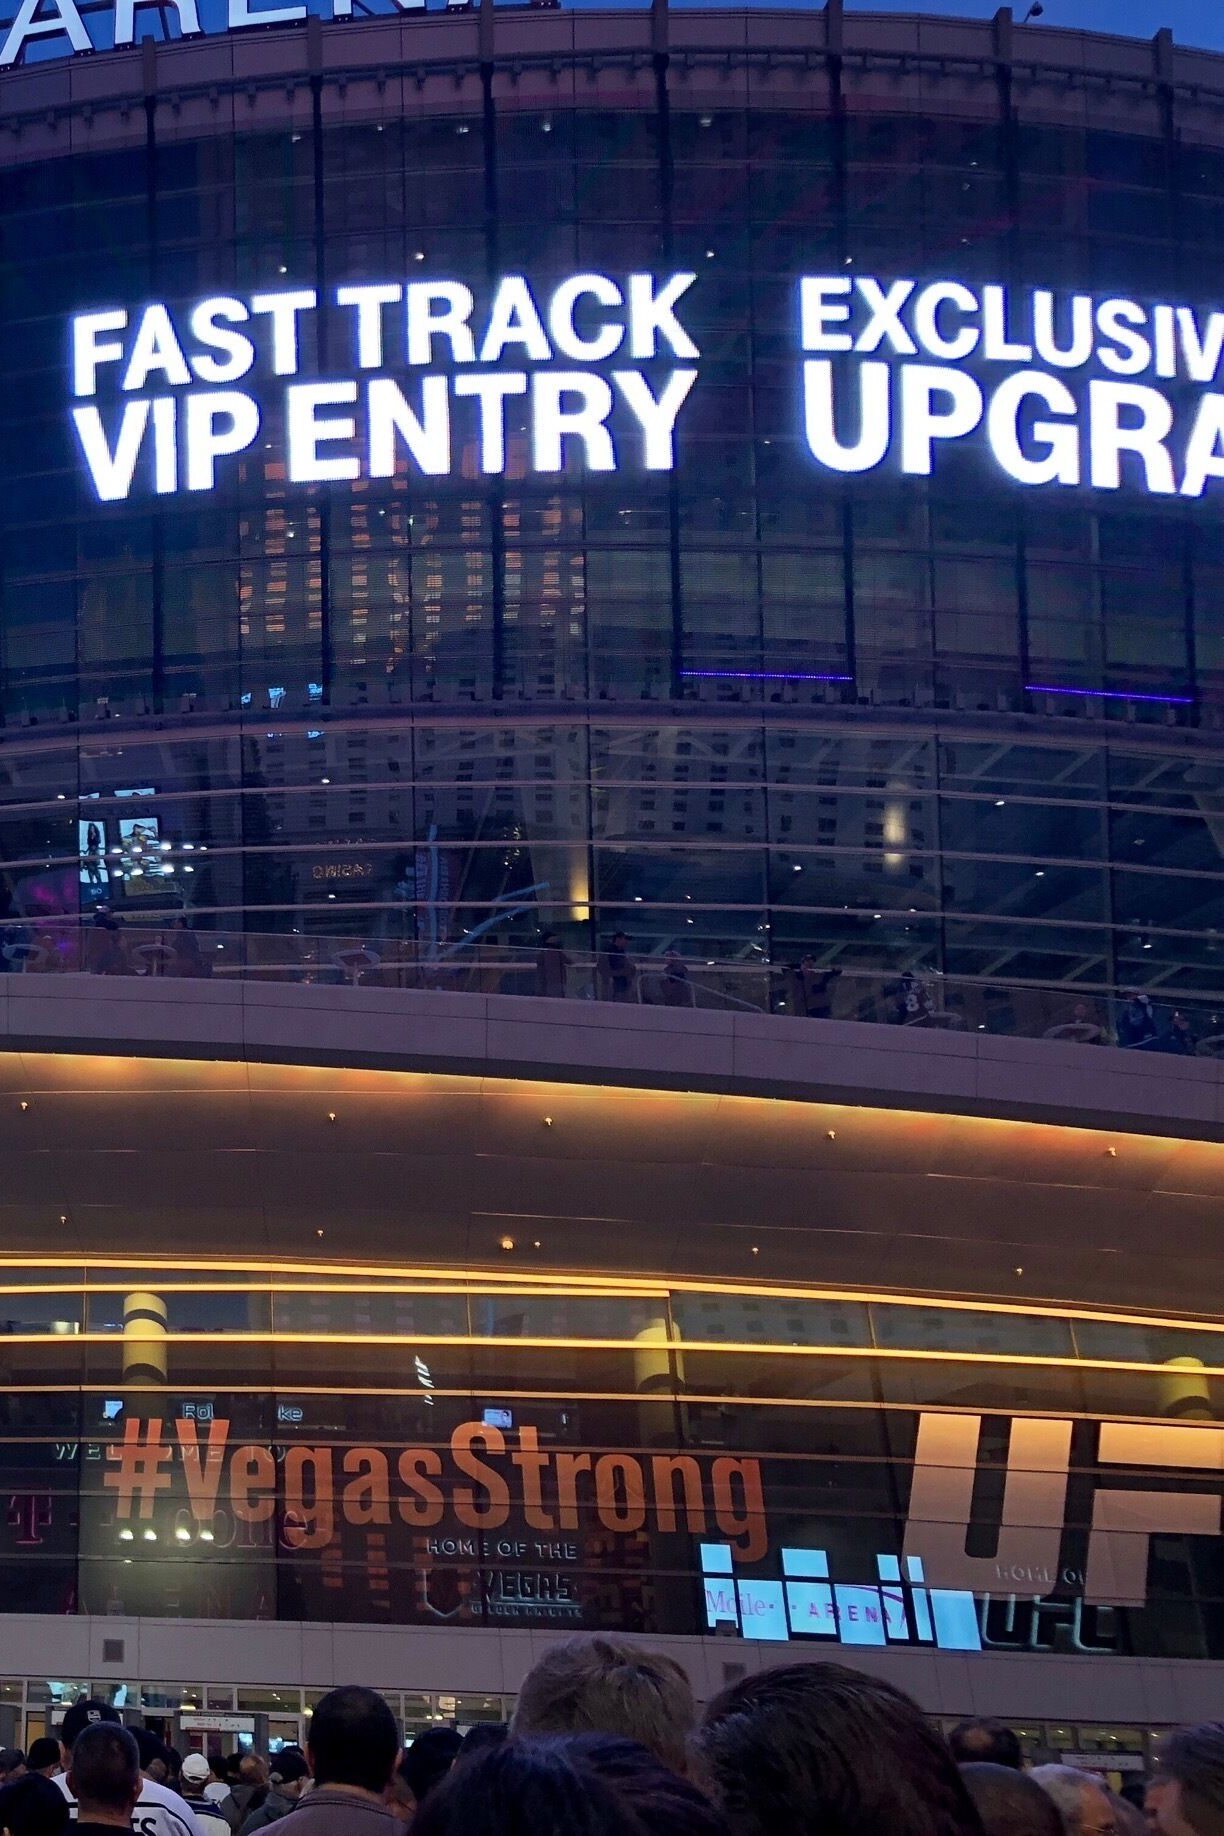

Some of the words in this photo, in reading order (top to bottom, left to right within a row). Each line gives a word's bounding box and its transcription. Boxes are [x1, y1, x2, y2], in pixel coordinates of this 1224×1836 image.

[72, 290, 318, 397] FAST
[337, 272, 701, 368] TRACK
[799, 276, 1224, 382] EXCLUSIV
[73, 390, 260, 503] VIP
[287, 369, 698, 484] ENTRY
[103, 1418, 769, 1563] #VegasStrong
[534, 1542, 577, 1559] THE
